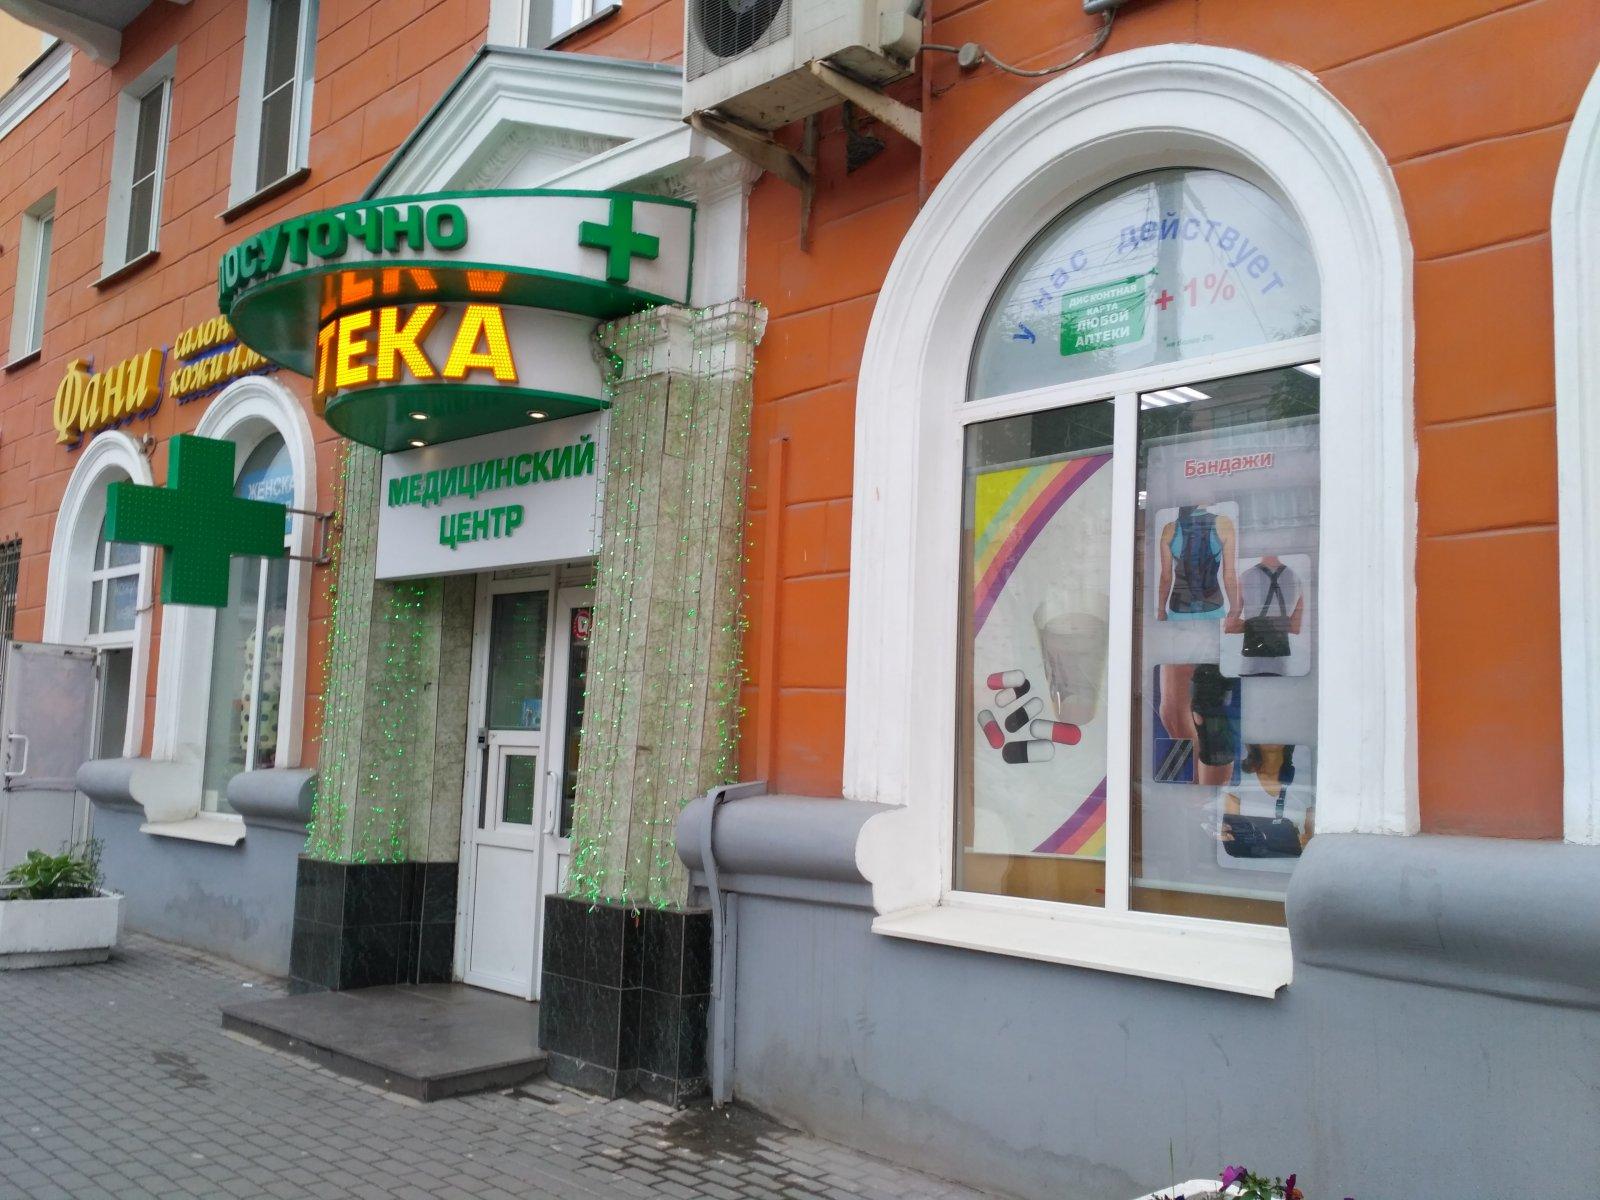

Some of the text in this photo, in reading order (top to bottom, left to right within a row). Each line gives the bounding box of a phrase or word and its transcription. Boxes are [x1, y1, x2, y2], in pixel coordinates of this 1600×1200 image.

[1031, 249, 1088, 311] нас
[1117, 211, 1284, 296] действует
[1069, 284, 1137, 309] ДИСКОНТНАЯ
[1086, 302, 1118, 316] КАРТА
[1075, 326, 1130, 348] АПТЕКИ
[1077, 310, 1129, 332] ЛЮБОЙ
[317, 304, 519, 396] ТЕКА
[53, 346, 157, 445] Фани
[387, 445, 596, 508] МЕДИЦИНСКИЙ
[1184, 452, 1273, 478] Бандажи
[439, 504, 524, 551] ЦЕНТР
